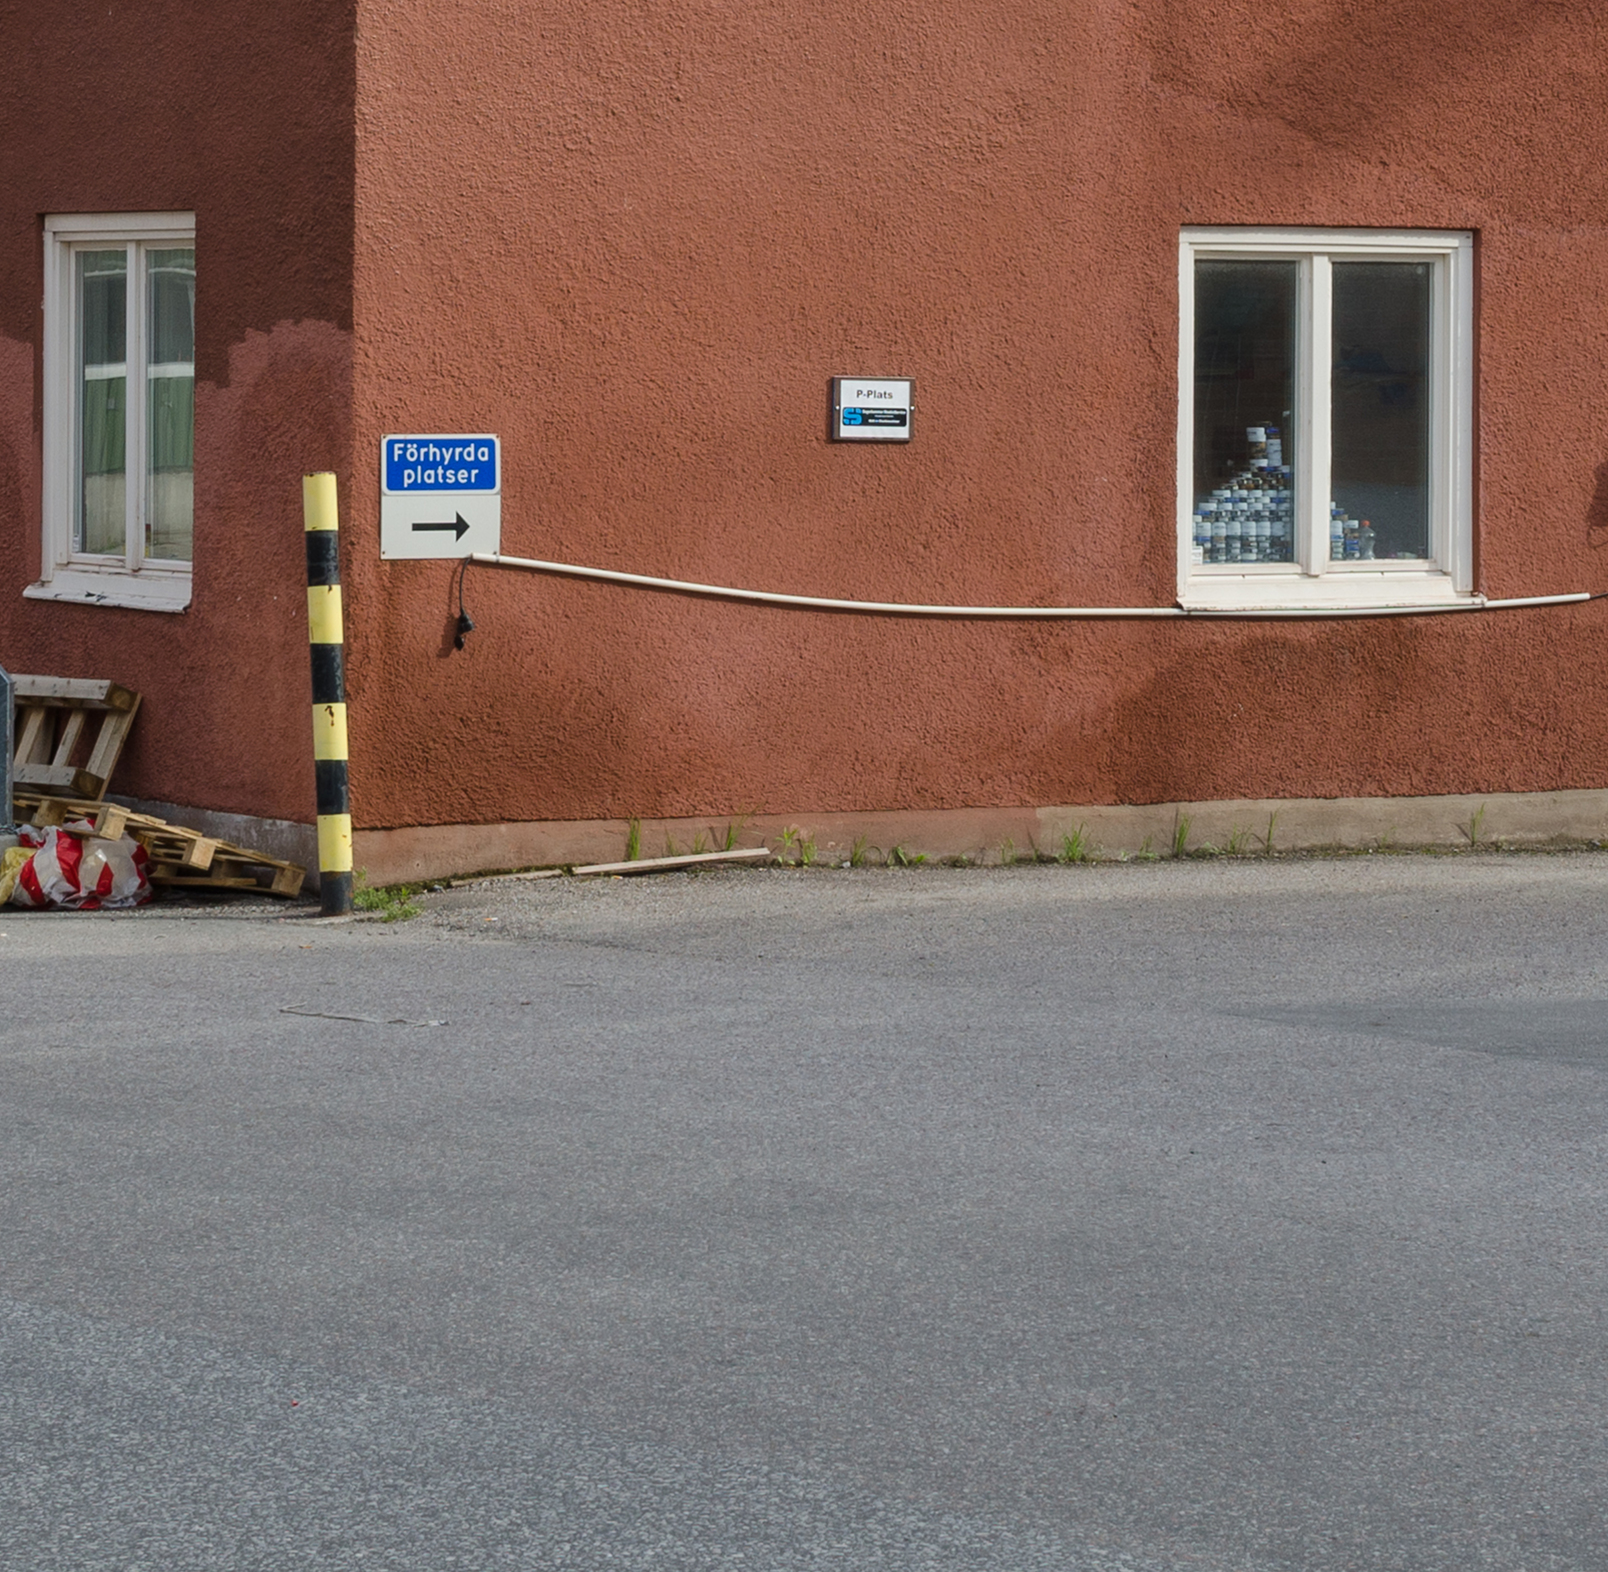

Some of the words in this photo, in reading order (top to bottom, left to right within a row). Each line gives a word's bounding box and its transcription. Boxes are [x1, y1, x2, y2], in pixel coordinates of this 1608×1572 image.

[856, 389, 893, 399] P-Plats
[394, 443, 489, 465] Förhyrda
[403, 465, 479, 488] platser
